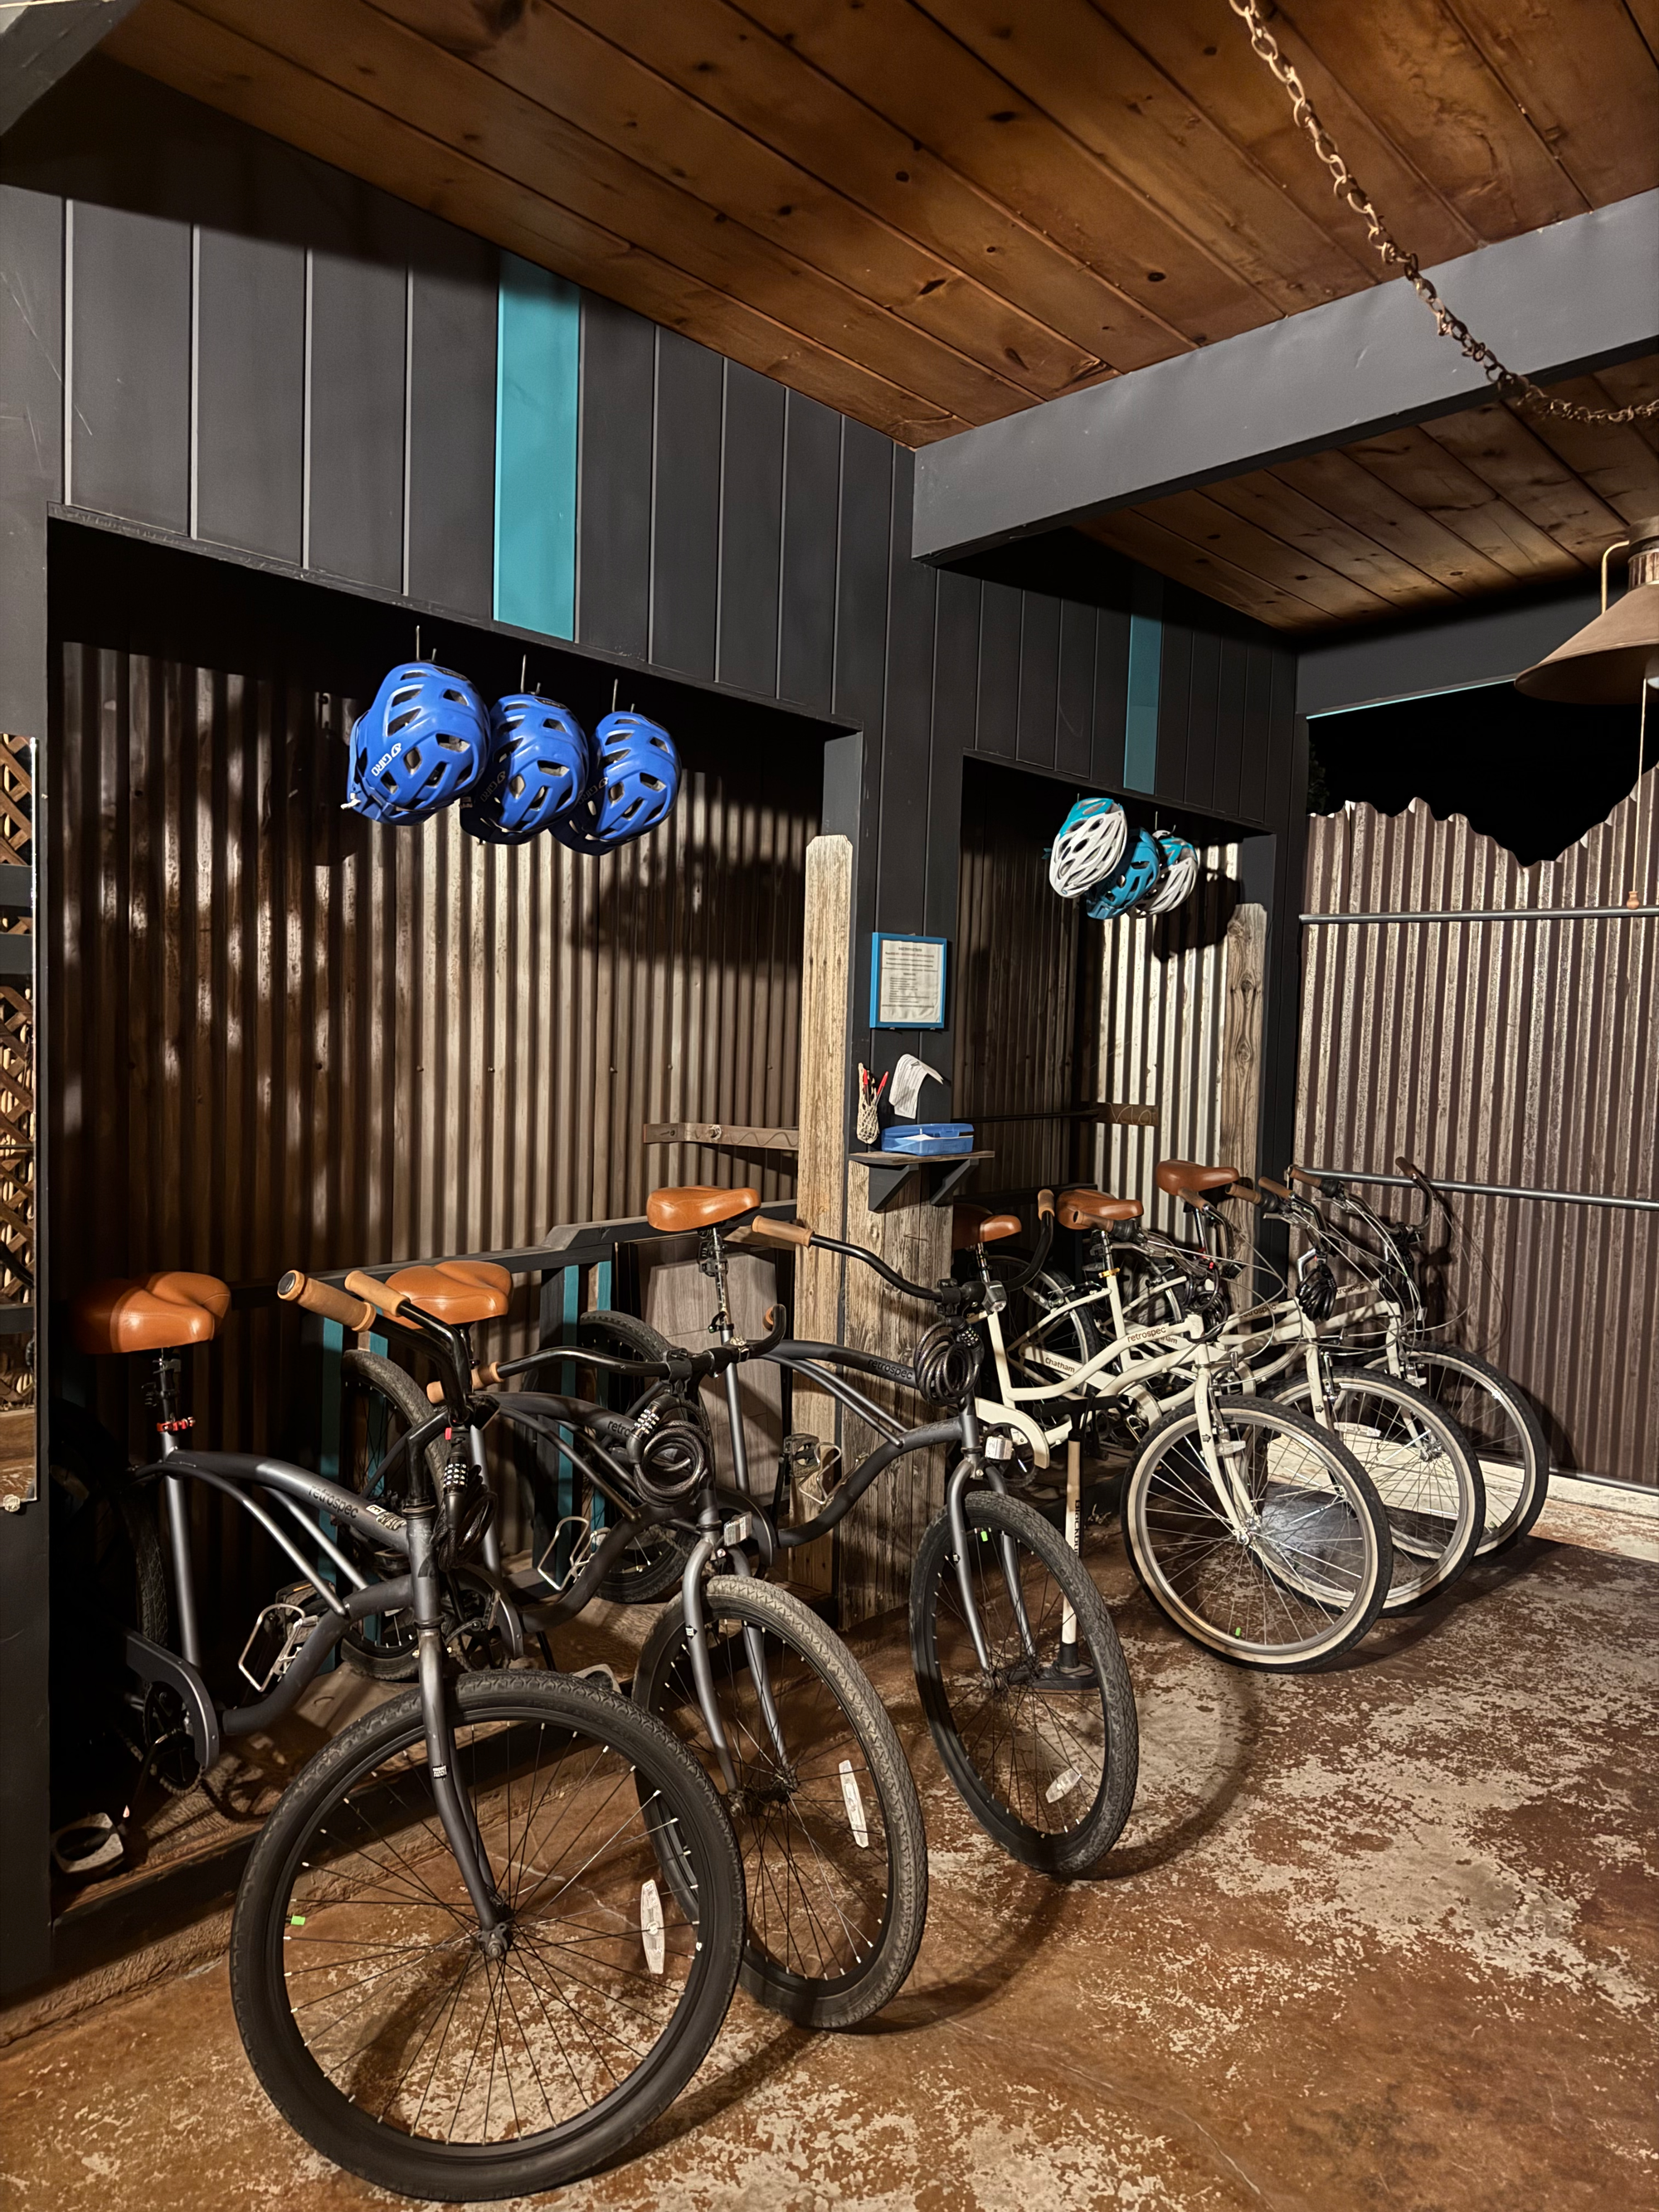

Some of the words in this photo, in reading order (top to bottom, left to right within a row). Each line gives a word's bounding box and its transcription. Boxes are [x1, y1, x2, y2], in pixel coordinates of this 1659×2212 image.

[371, 752, 393, 777] GIRO
[479, 780, 499, 804] GIRO
[1126, 1325, 1167, 1344] retrospec
[868, 1359, 913, 1380] retrospec
[1044, 1357, 1076, 1373] Chatham
[607, 1420, 632, 1437] retro
[308, 1484, 359, 1519] retrospec
